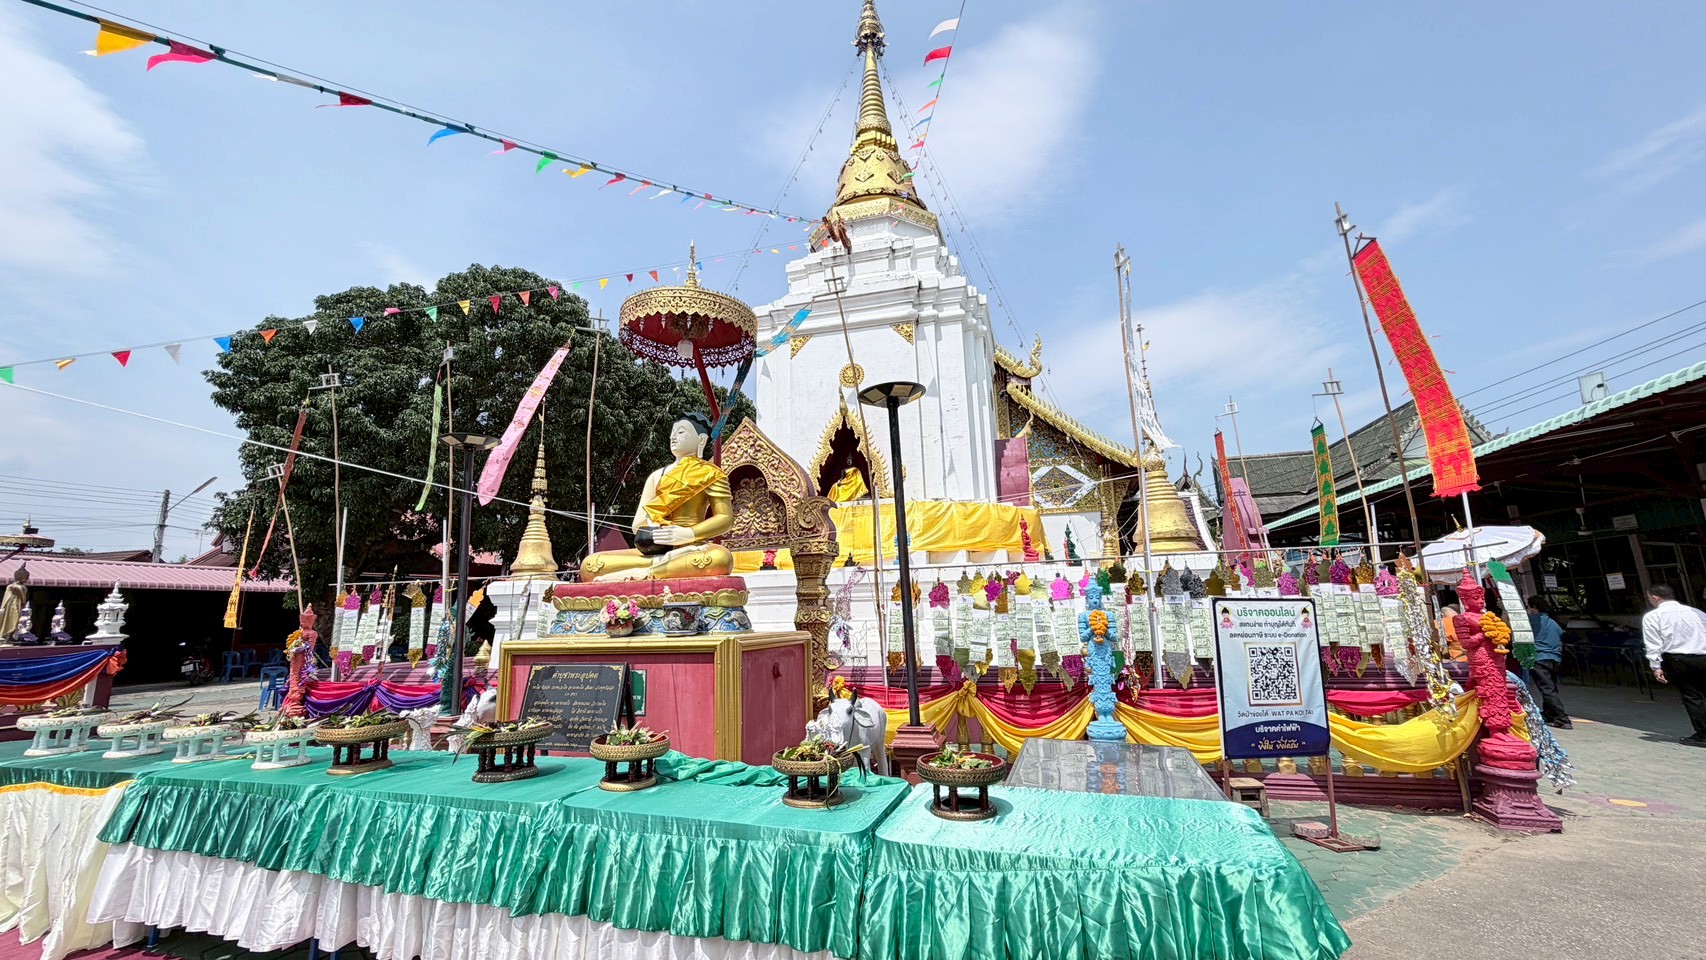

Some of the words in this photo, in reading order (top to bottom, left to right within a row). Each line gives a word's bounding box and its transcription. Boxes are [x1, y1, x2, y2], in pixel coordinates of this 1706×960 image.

[1237, 606, 1296, 617] บริจาคออนไลน์
[1255, 723, 1301, 733] บริจาคค่าไฟฟ้า
